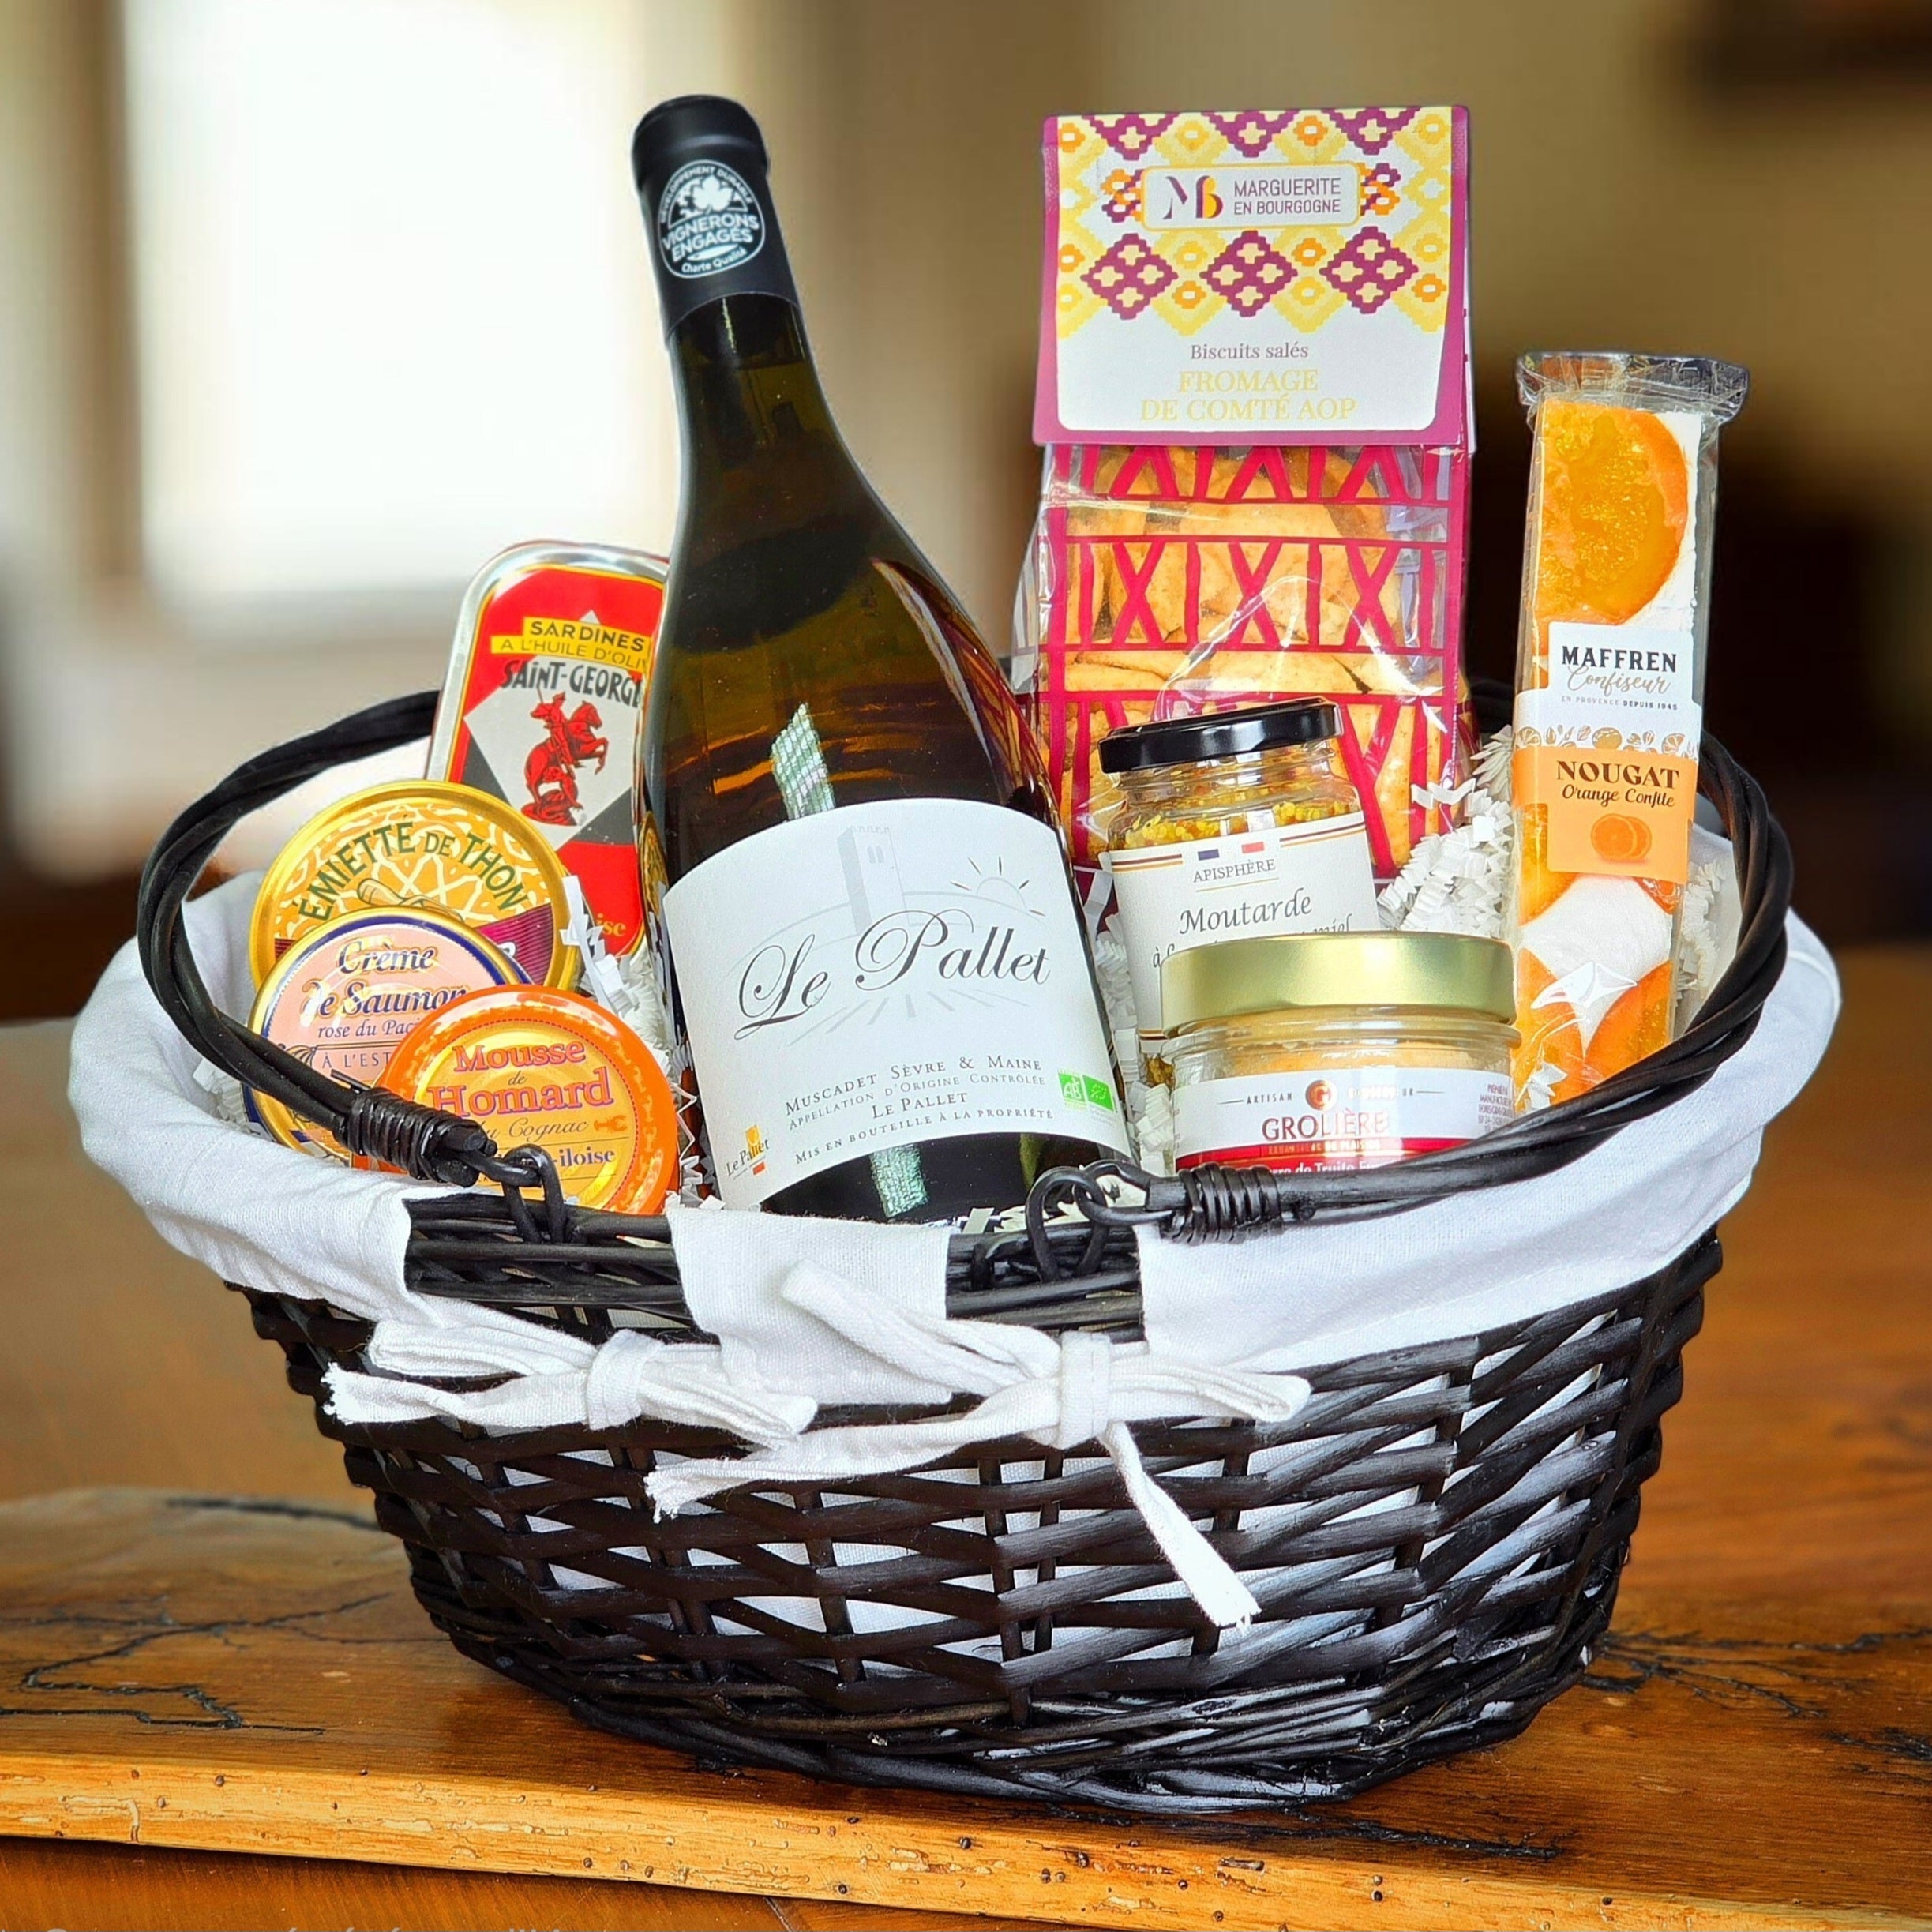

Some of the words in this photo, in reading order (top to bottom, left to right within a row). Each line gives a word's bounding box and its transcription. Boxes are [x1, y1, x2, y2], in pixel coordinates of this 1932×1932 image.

[1234, 178, 1341, 197] MARGUERITE
[1234, 201, 1252, 215] EN
[1256, 198, 1341, 215] BOURGOGNE
[662, 213, 760, 250] VIGNERONS
[681, 261, 711, 273] Charte
[1190, 343, 1260, 360] Biscuits
[1266, 341, 1308, 358] salés
[1178, 369, 1319, 392] FROMAGE
[1141, 400, 1178, 421] DE
[1186, 394, 1290, 420] COMTÉ
[1299, 398, 1356, 419] AOP
[530, 621, 644, 651] SARDINES
[521, 639, 587, 657] L'HUILE
[594, 647, 647, 670] D'OLIV
[1562, 645, 1677, 673] MAFFREN
[1567, 665, 1671, 696] Confiseur
[1576, 696, 1619, 706] PROVENCE
[1557, 760, 1679, 789] NOUGAT
[1562, 784, 1619, 808] Orange
[1625, 788, 1675, 808] Confite
[423, 831, 456, 857] DE
[458, 831, 529, 911] THON
[1193, 859, 1276, 883] APISPHÈRE
[1180, 887, 1312, 935] Moutarde
[339, 941, 434, 974] Crème
[734, 934, 831, 1041] Le
[855, 909, 1051, 991] Pallet
[317, 1026, 350, 1038] rose
[355, 1019, 377, 1037] du
[452, 1041, 586, 1072] Mousse
[426, 1067, 614, 1117] Homard
[508, 1070, 527, 1086] de
[786, 1073, 877, 1116] MUSCADET
[959, 1056, 974, 1069] &
[987, 1055, 1041, 1071] MAINE
[1247, 1092, 1292, 1104] ARTISAN
[508, 1117, 588, 1142] Cognac
[826, 1139, 842, 1151] EN
[849, 1116, 932, 1142] BOUTEILLE
[954, 1110, 971, 1120] LA
[977, 1107, 1053, 1119] PROPRIÉTÉ
[1262, 1108, 1389, 1141] GROLIÈRE
[726, 1160, 739, 1176] Le
[740, 1139, 769, 1165] Pallet
